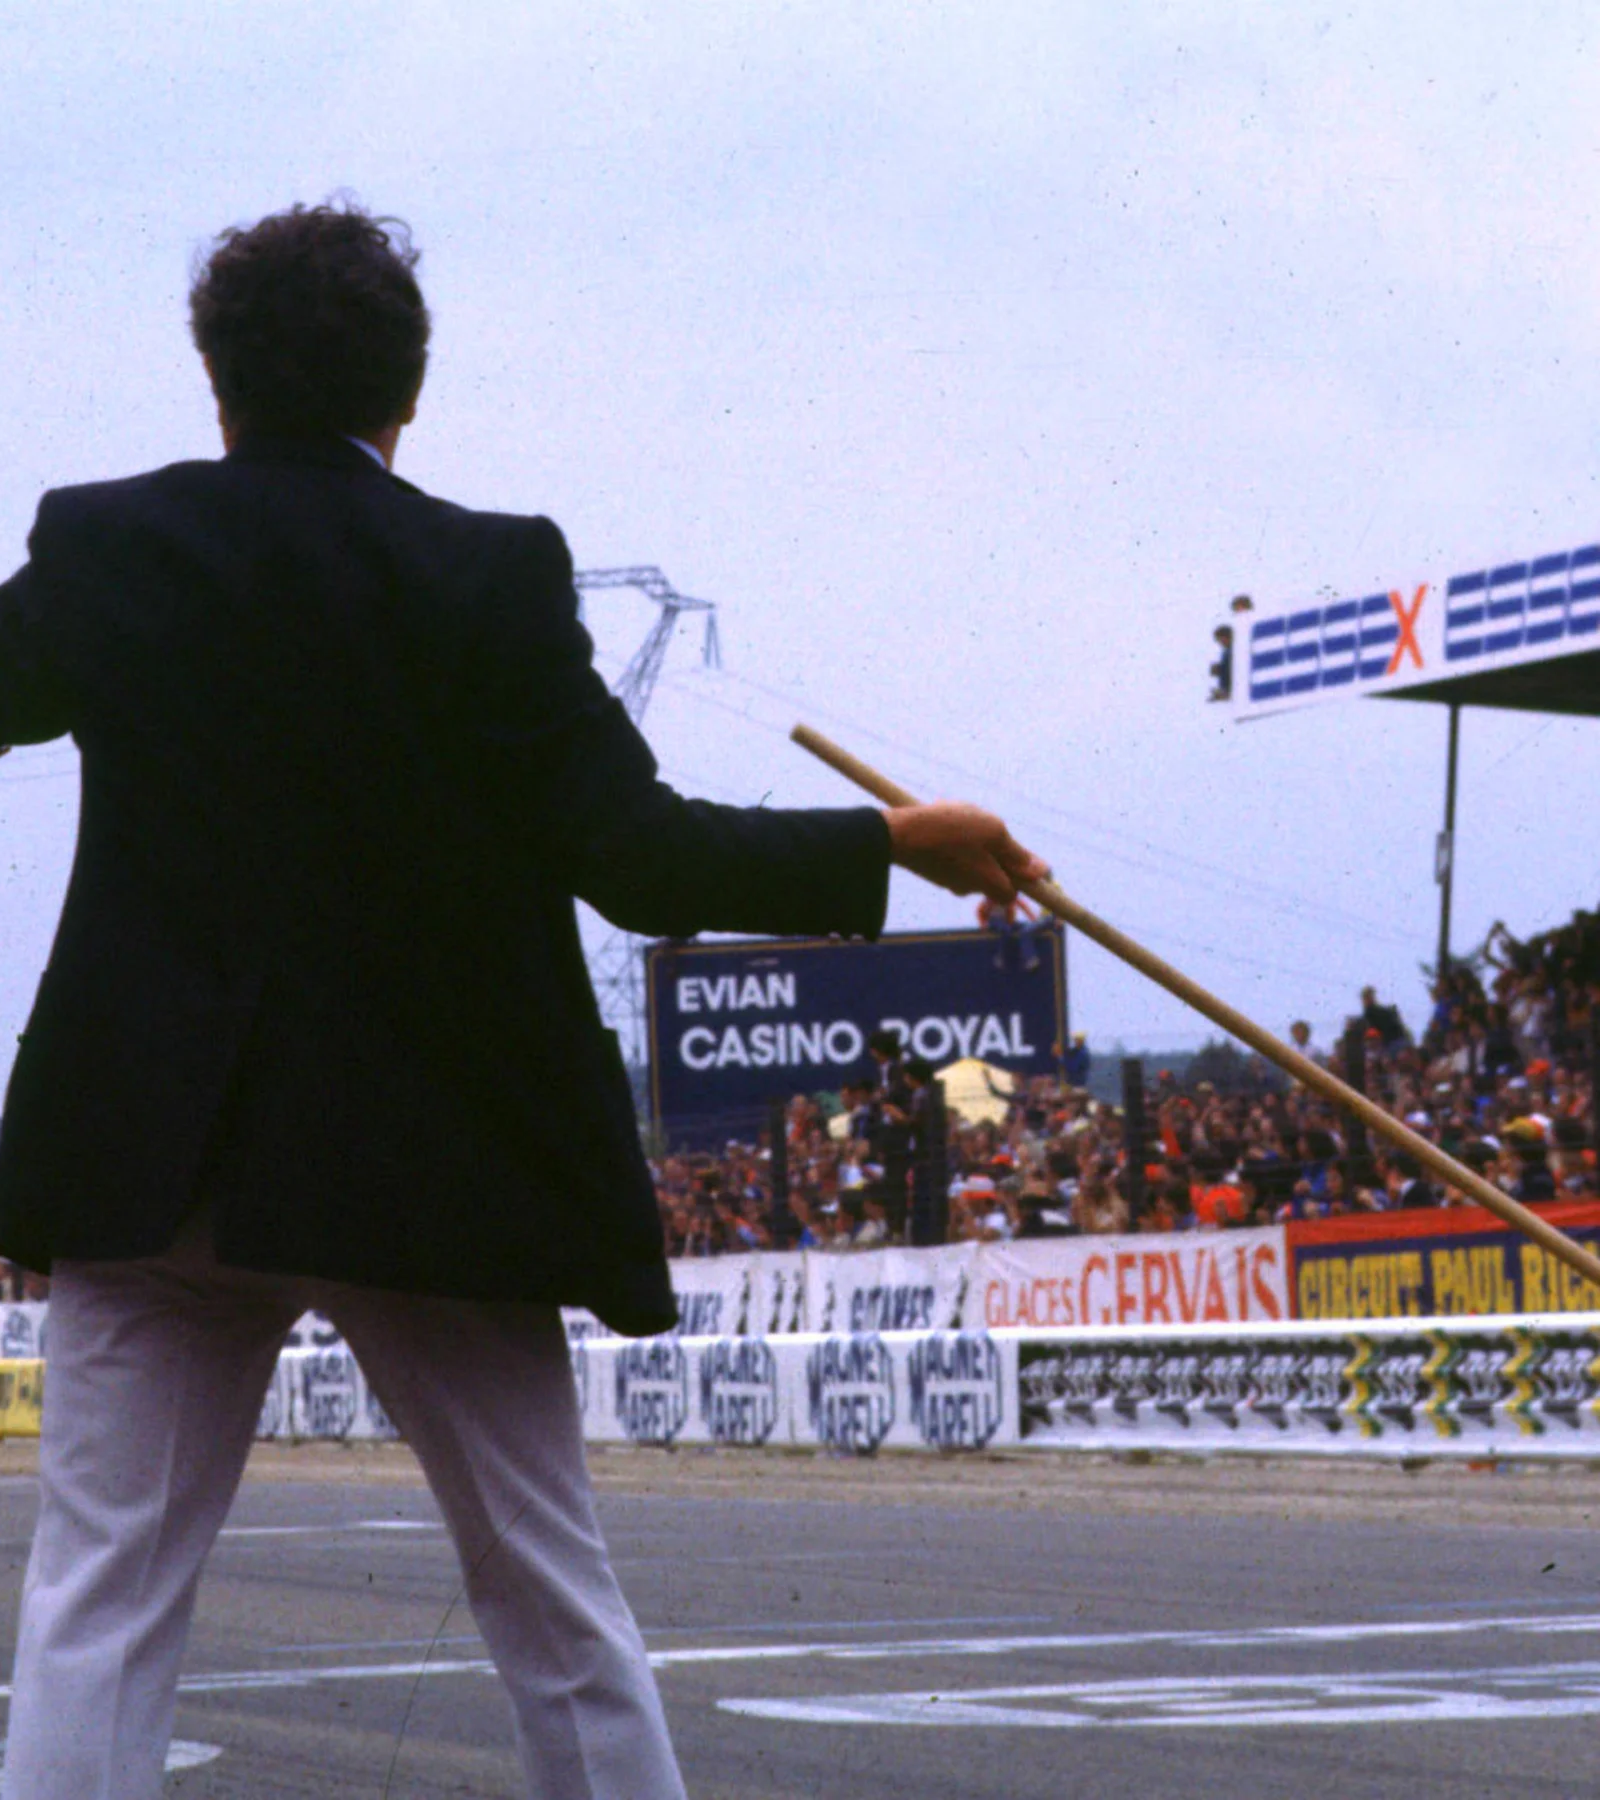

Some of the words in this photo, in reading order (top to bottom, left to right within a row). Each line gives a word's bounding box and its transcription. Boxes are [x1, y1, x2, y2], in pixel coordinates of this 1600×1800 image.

[677, 972, 796, 1012] EVIAN
[680, 1019, 863, 1070] CASINO
[985, 1276, 1075, 1327] GLACES
[1080, 1243, 1281, 1325] GERVAIS
[1300, 1251, 1422, 1320] CIRCUIT
[1430, 1246, 1515, 1317] PAUL
